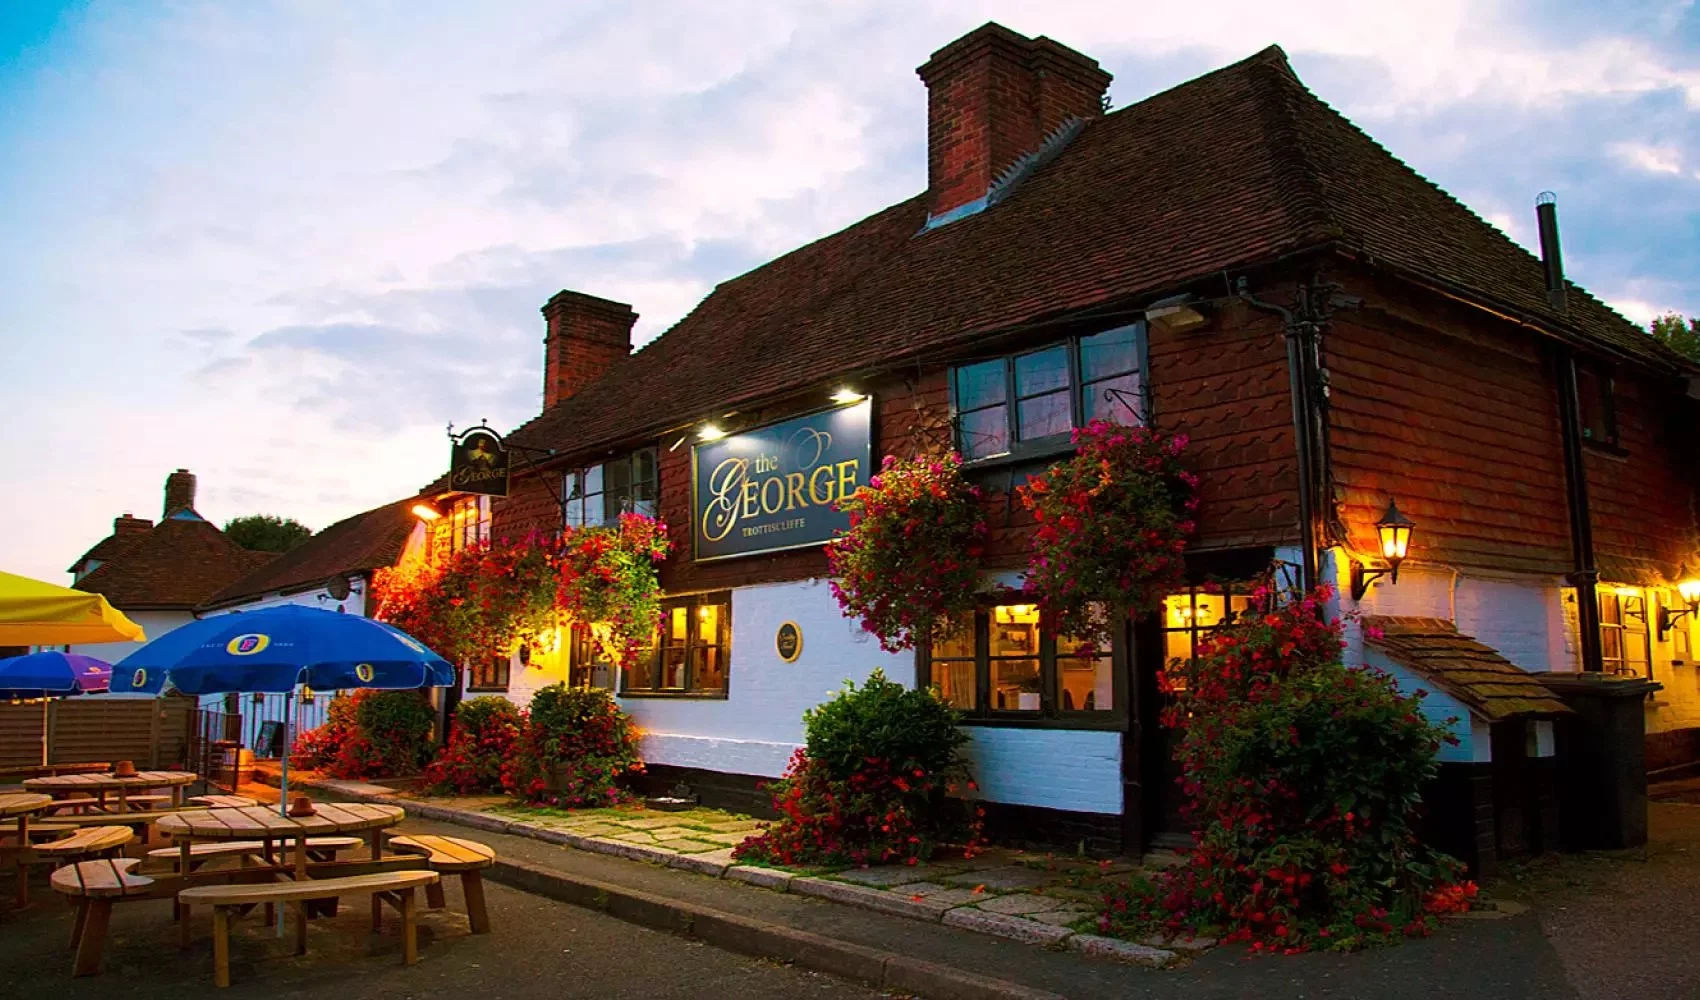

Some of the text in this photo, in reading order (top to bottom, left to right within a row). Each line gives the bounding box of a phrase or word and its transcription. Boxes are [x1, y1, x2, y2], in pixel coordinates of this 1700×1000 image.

[755, 453, 779, 474] the
[702, 457, 859, 542] GEORGE
[742, 518, 806, 537] TROTTISCLIFFE
